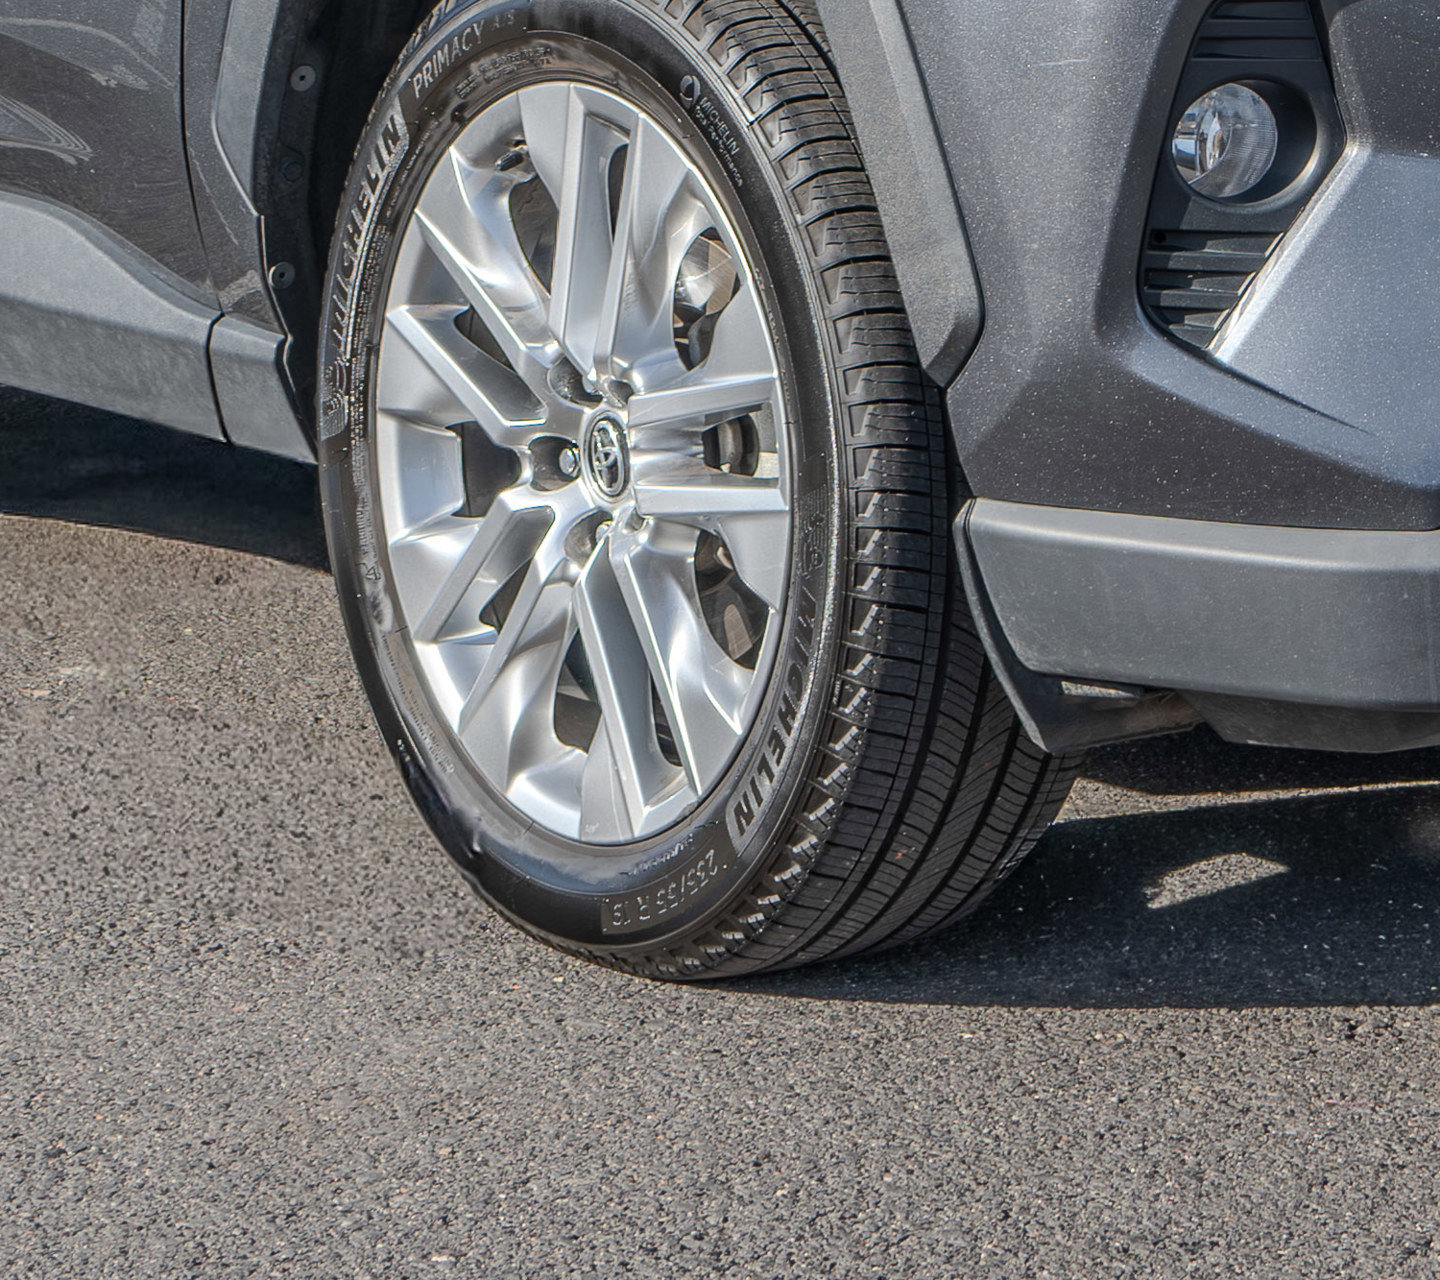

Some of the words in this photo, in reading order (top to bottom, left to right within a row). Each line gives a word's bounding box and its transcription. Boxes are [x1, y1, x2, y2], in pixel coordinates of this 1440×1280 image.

[412, 18, 485, 99] PRIMACY
[700, 96, 740, 156] MICHELIN
[733, 584, 818, 838] MICHELIN
